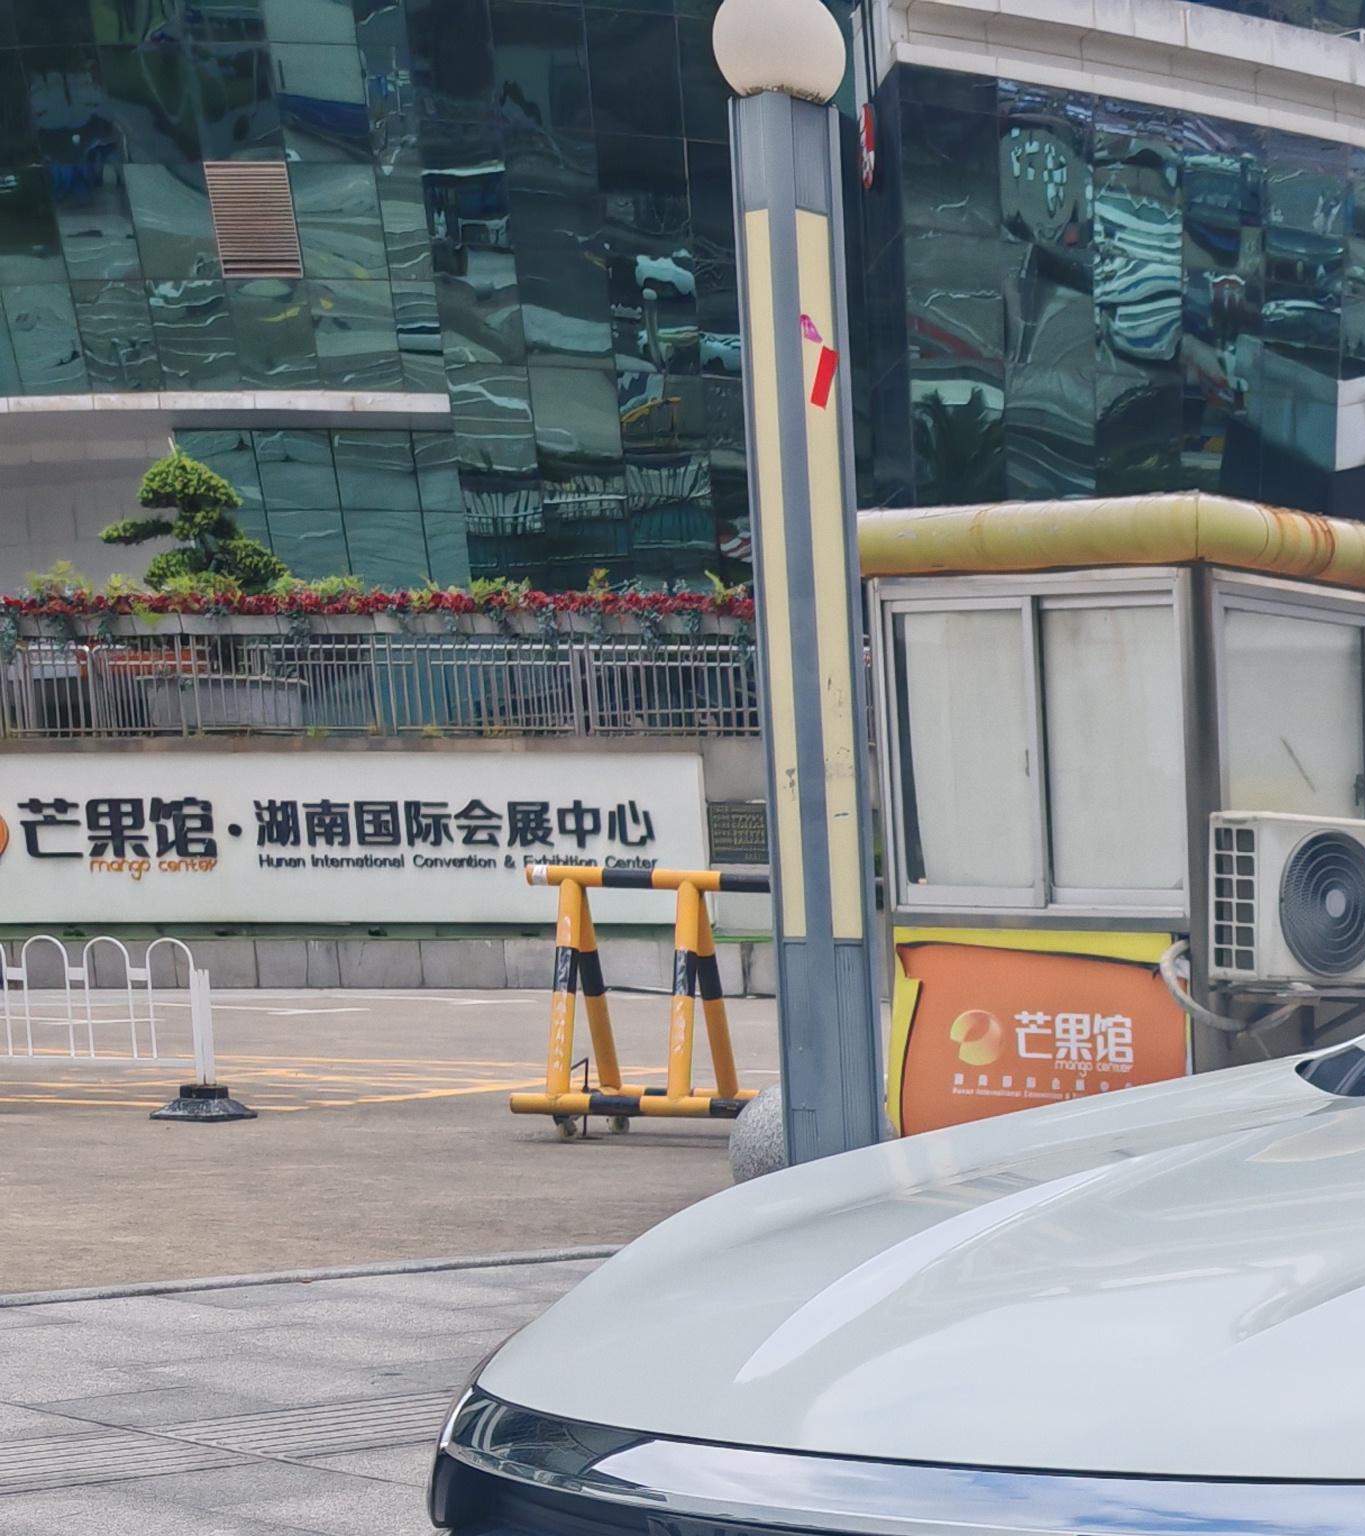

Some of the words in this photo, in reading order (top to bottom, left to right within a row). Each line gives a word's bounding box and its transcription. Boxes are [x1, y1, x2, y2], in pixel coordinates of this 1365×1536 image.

[90, 859, 150, 881] mango
[259, 854, 306, 868] Hunan
[311, 854, 405, 868] International
[413, 854, 497, 869] Convention
[504, 855, 516, 869] &
[1014, 1010, 1134, 1063] 芒果馆
[1054, 1059, 1092, 1077] mango
